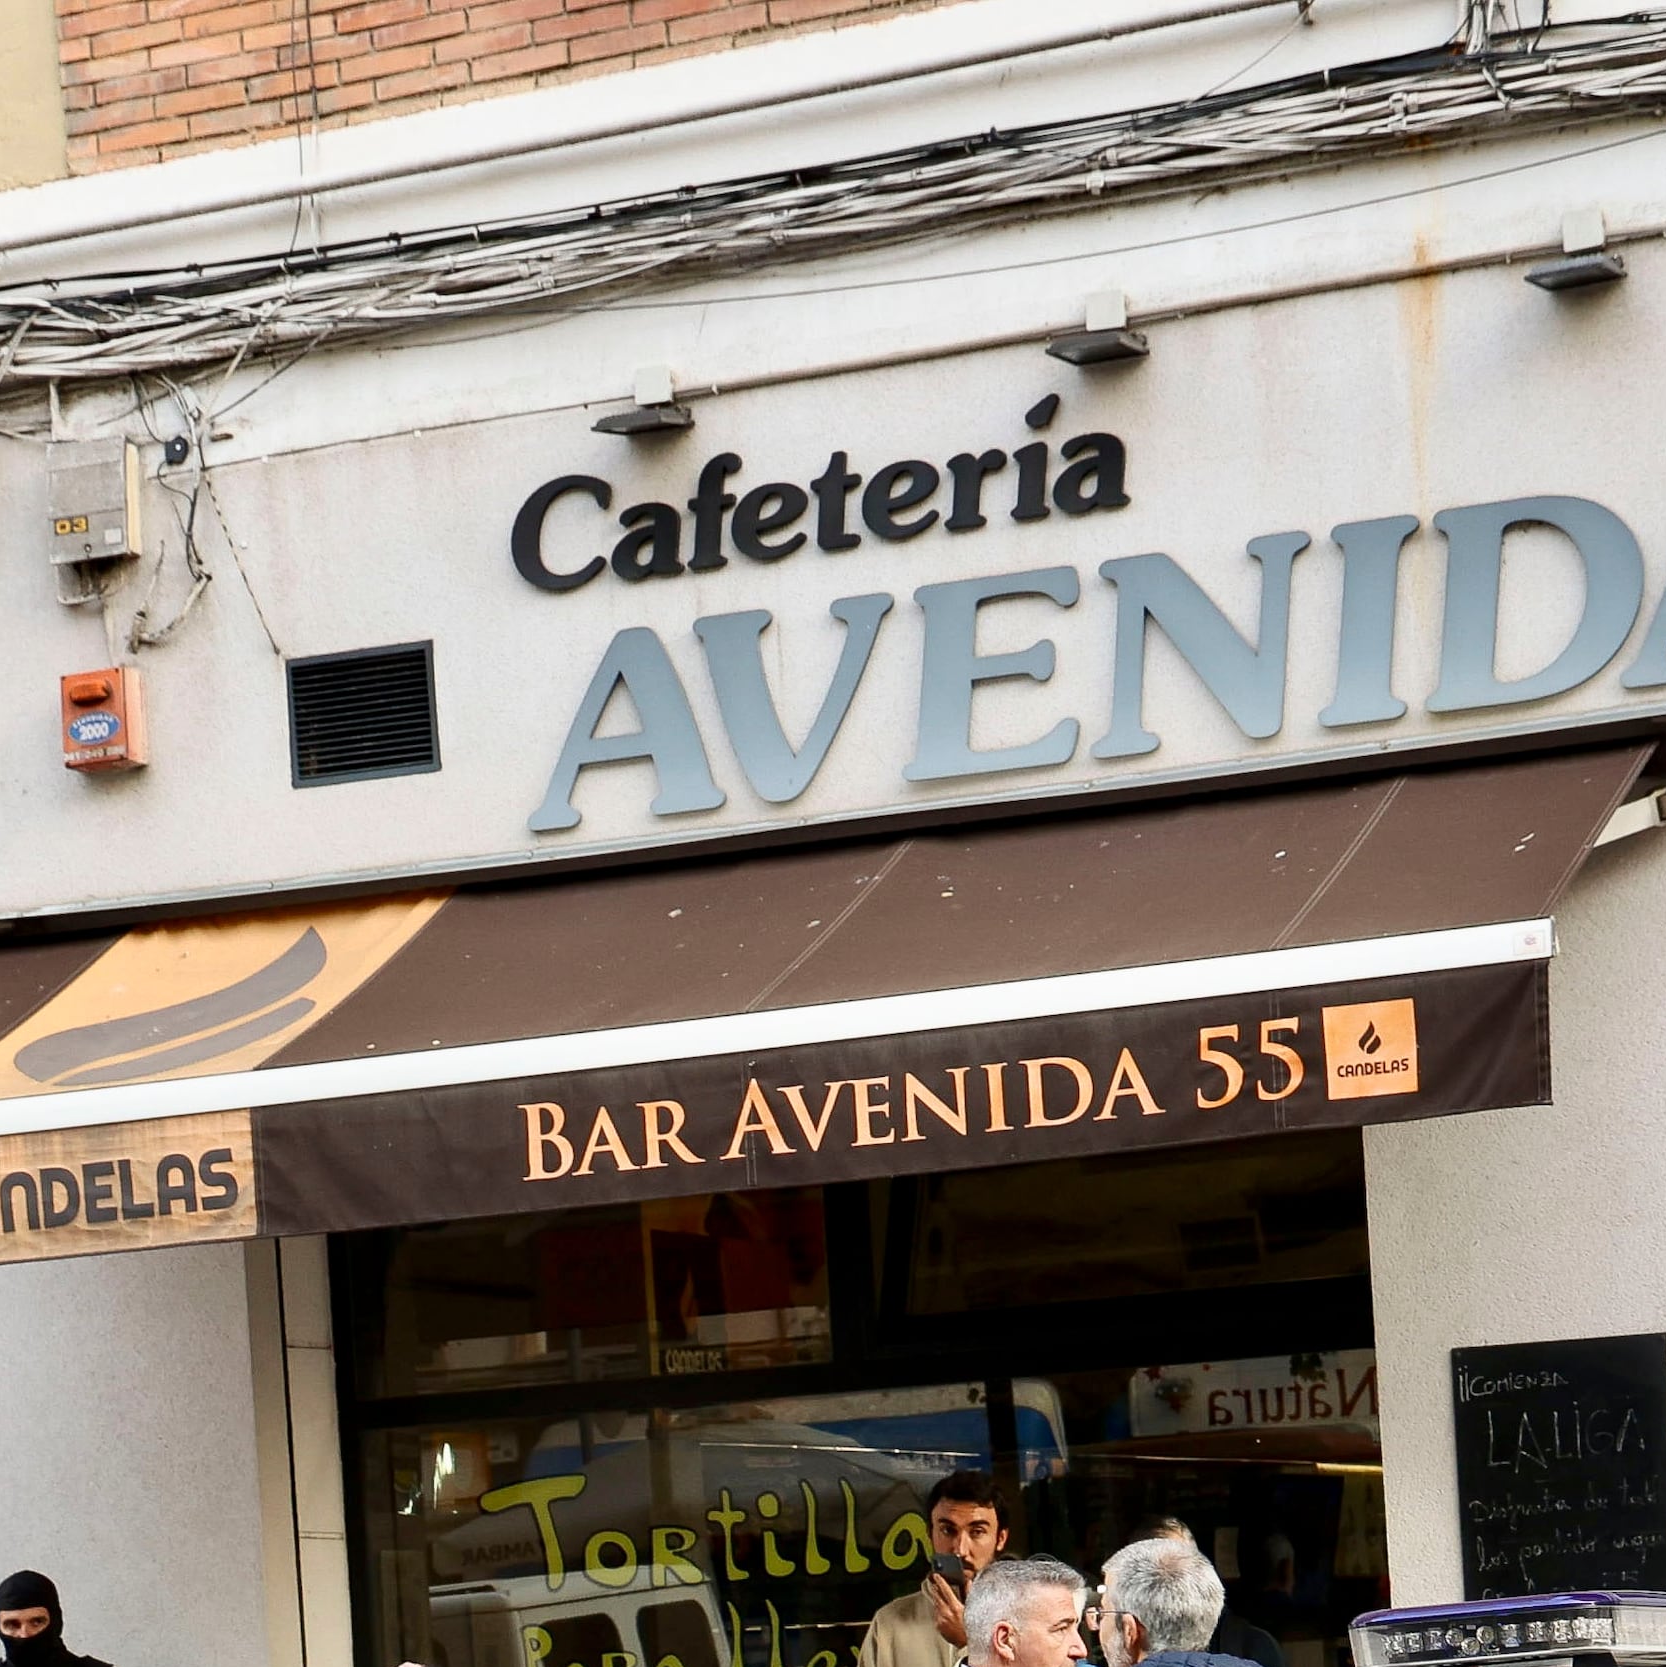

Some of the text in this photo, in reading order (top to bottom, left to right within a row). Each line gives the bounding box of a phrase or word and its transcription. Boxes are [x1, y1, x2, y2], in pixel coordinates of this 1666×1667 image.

[510, 393, 1131, 591] Cafetería
[78, 721, 110, 741] 2000
[517, 1015, 1307, 1183] BAR AVENIDA 55
[1336, 1058, 1410, 1078] CANDELAS
